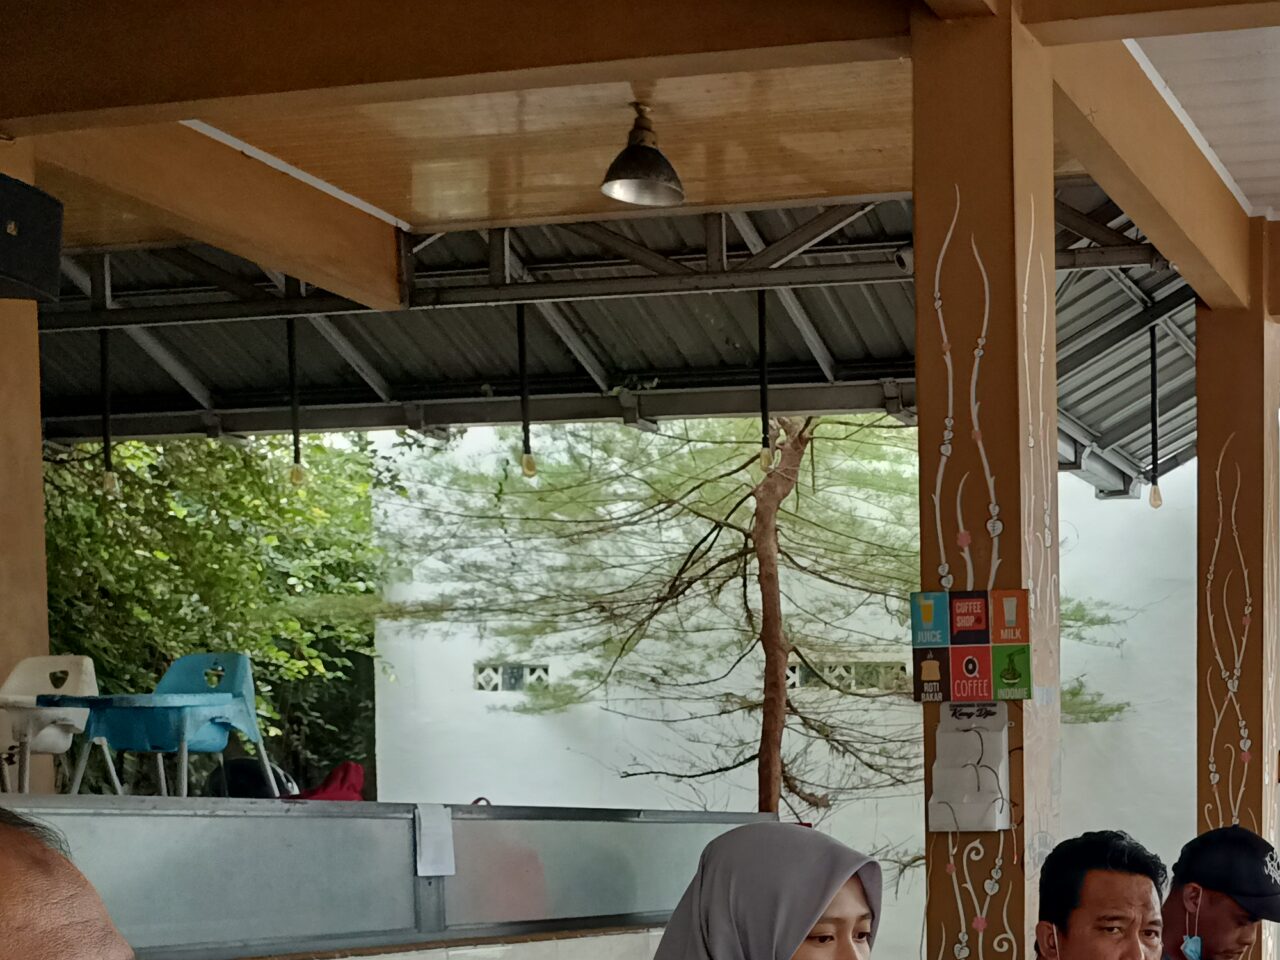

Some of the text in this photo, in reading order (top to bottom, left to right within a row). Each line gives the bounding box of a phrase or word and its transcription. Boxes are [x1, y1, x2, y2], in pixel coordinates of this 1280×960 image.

[955, 601, 981, 613] COFFEE
[956, 615, 975, 627] SHOP
[917, 630, 942, 643] JUICE
[1000, 628, 1022, 640] MILK
[923, 682, 939, 692] ROTI
[954, 680, 989, 697] COFFEE
[997, 687, 1028, 699] INDOMIE
[921, 692, 942, 702] BAKAR
